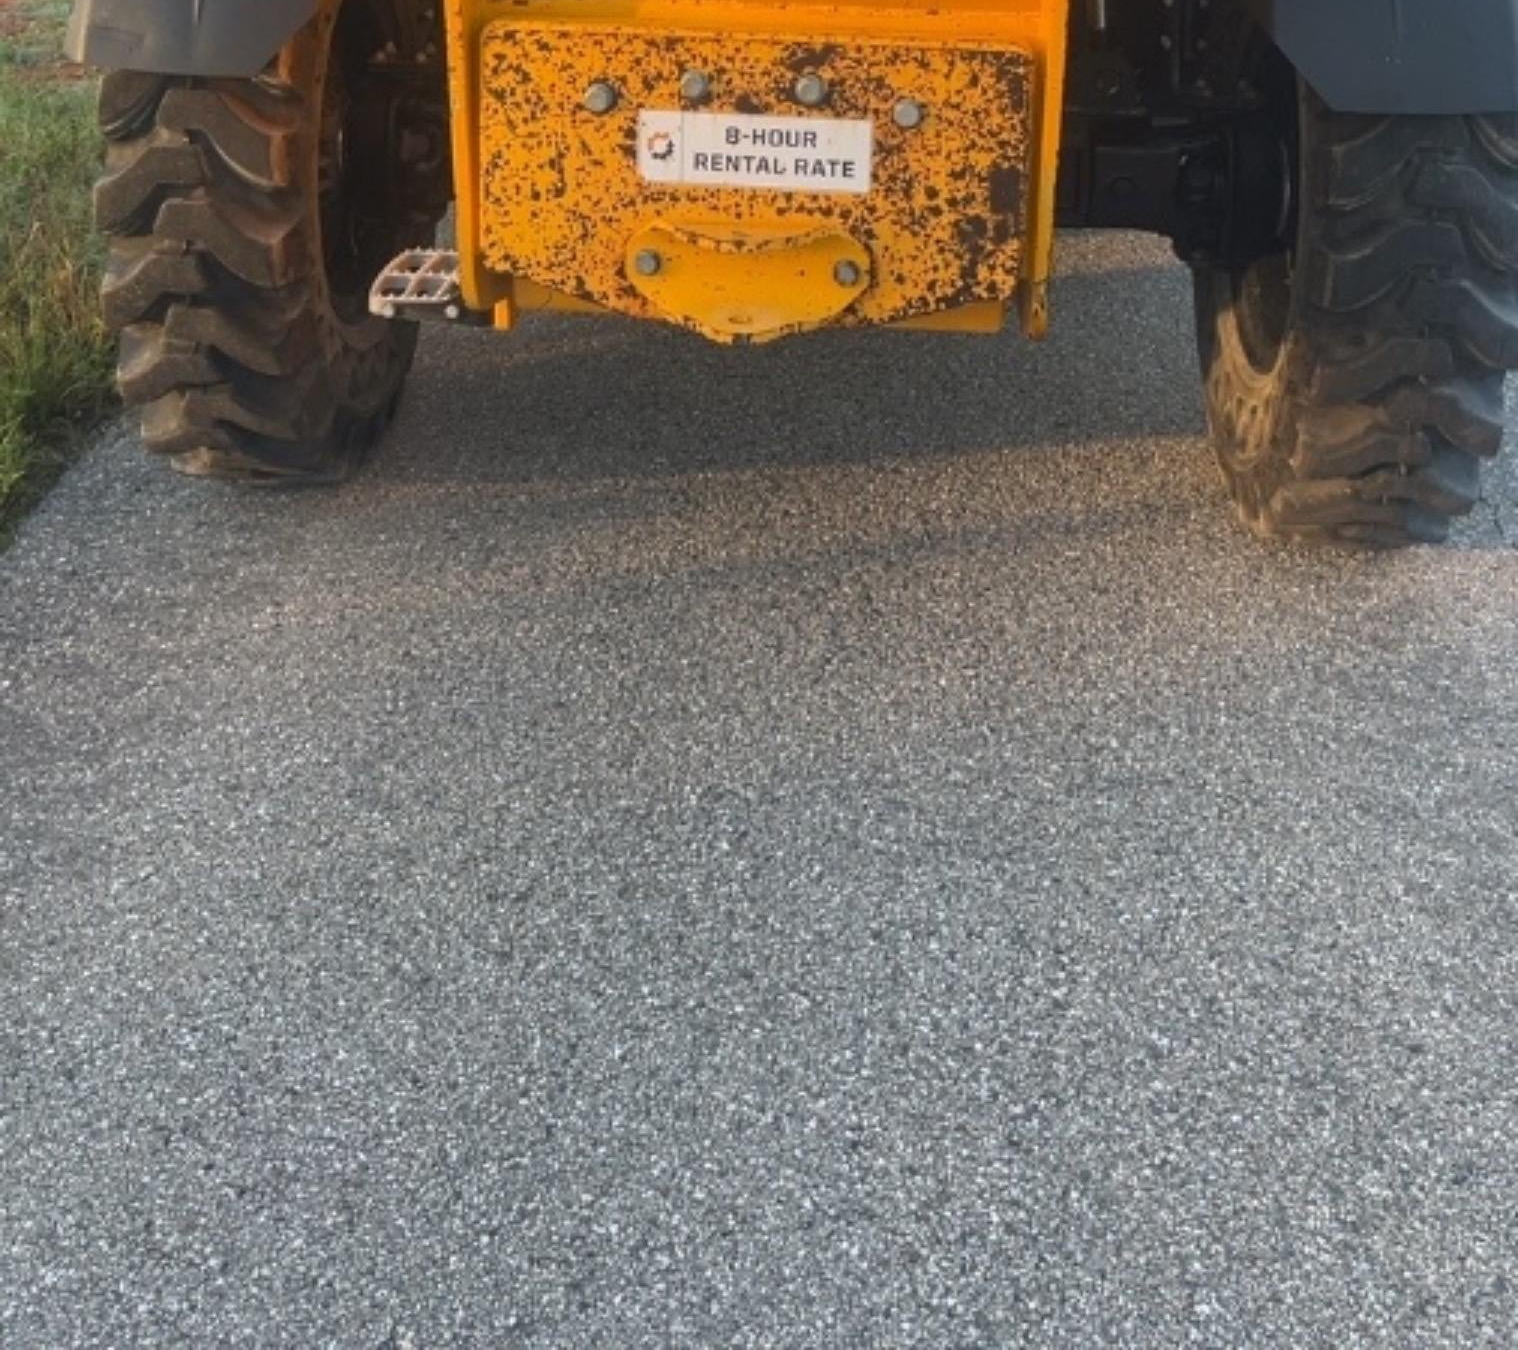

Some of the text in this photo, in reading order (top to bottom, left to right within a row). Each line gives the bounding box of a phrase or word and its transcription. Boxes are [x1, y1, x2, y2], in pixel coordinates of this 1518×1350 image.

[725, 126, 818, 148] 8-HOUR
[693, 152, 856, 178] RENTAL RATE
